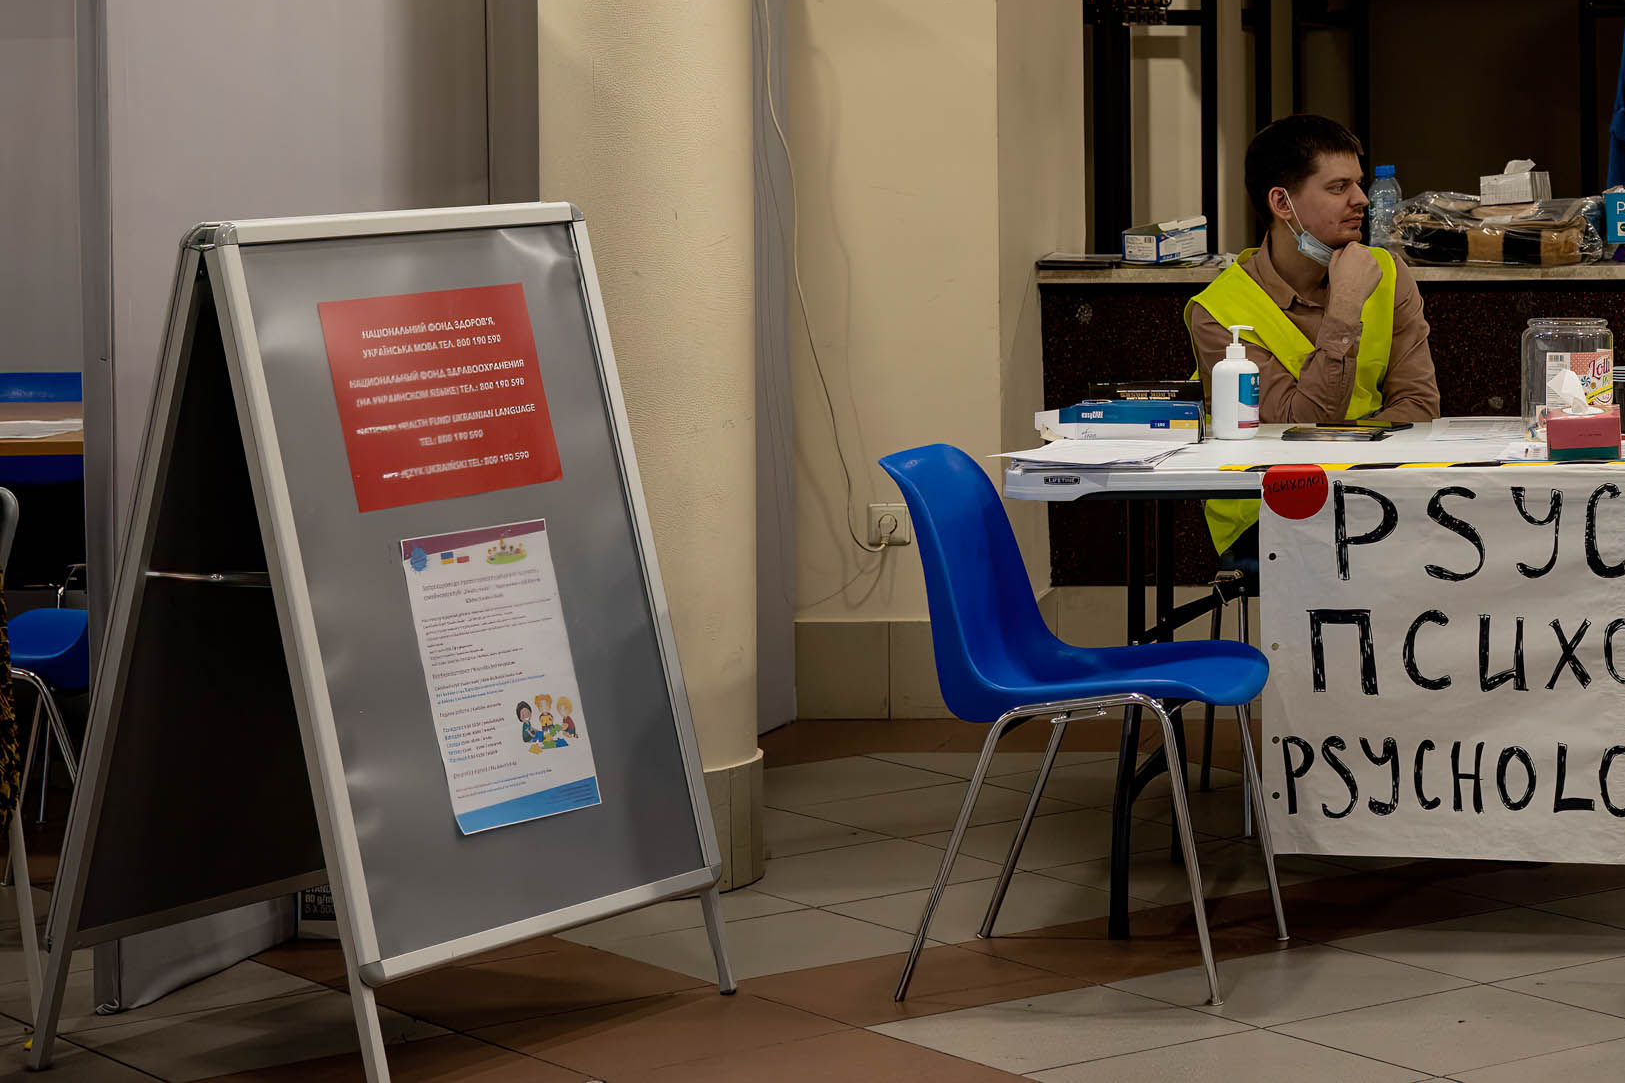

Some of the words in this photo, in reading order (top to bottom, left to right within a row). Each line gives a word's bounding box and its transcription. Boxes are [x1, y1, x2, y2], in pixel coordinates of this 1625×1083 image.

[428, 321, 454, 332] ФОНД
[456, 337, 471, 347] 800
[472, 335, 487, 345] 190
[487, 334, 502, 344] 590
[480, 381, 494, 391] 800
[495, 379, 510, 389] 190
[511, 377, 525, 387] 590
[494, 403, 536, 417] LANGUAGE
